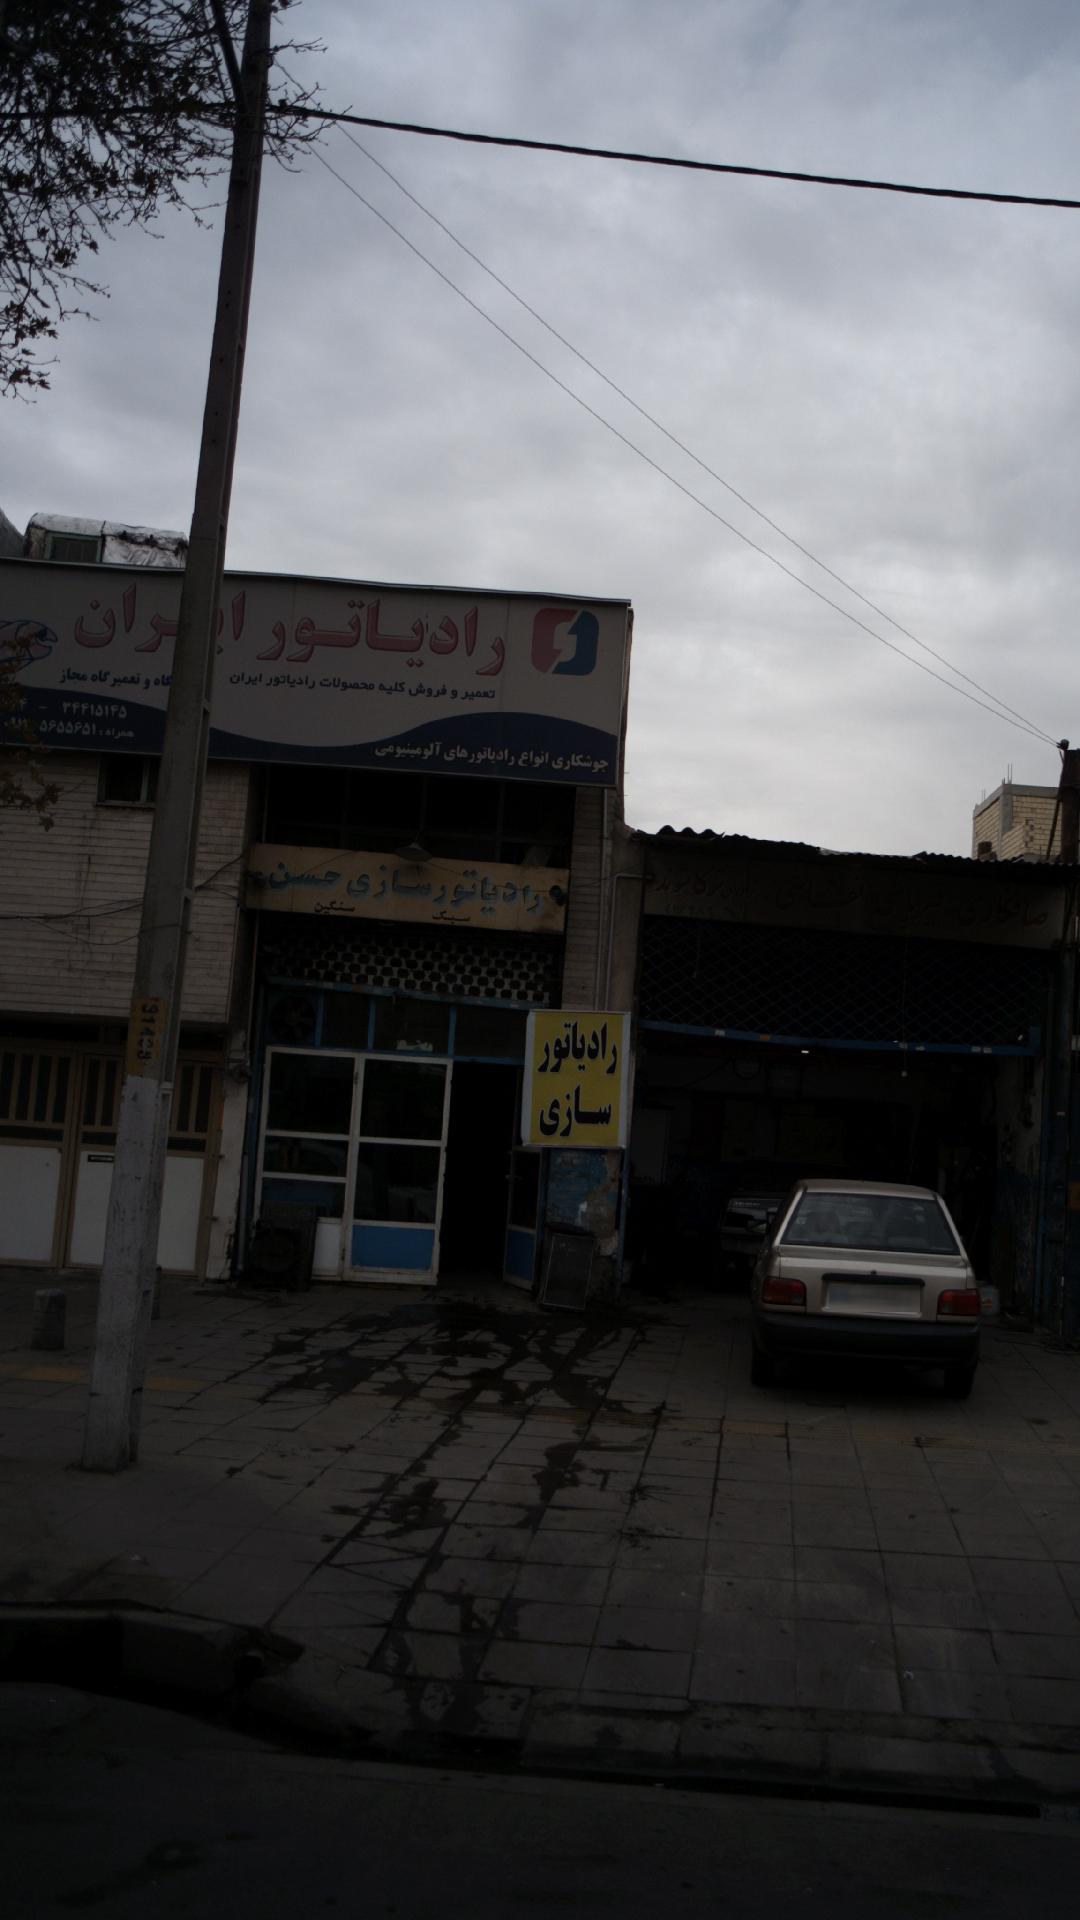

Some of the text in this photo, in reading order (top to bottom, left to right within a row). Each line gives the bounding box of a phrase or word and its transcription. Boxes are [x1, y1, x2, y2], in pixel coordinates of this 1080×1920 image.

[256, 598, 506, 677] رادیاتور
[59, 667, 88, 683] مجاز
[229, 671, 496, 701] تعمیر و فروش کلیه محصولات رادیاتور ایران
[375, 741, 442, 760] آلومینیومی
[518, 750, 549, 768] انواع
[551, 753, 609, 773] جوشکاری
[269, 862, 341, 890] حسن
[313, 900, 356, 914] سنگین
[537, 1020, 618, 1075] رادیاتور
[538, 1084, 612, 1137] سازی
